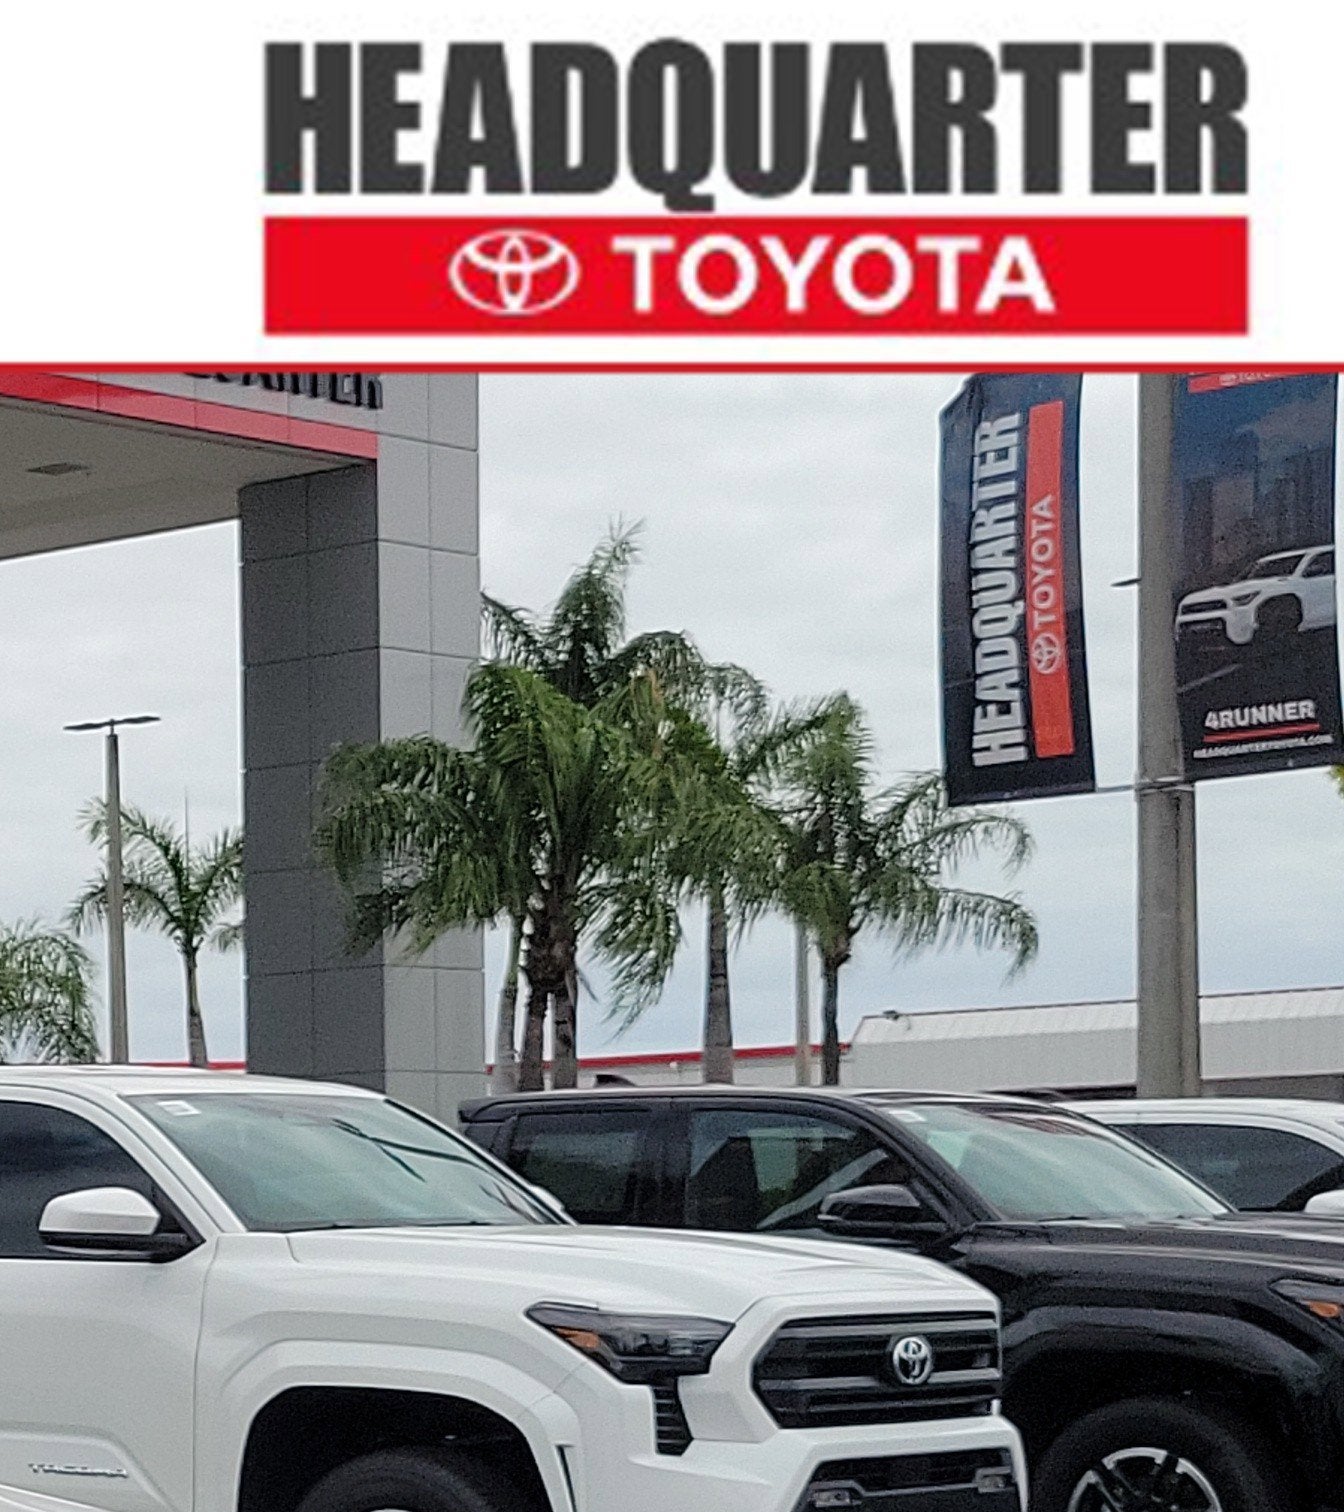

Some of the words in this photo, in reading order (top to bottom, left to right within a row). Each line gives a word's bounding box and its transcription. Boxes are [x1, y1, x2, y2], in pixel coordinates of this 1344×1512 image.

[970, 411, 1026, 766] HEADQUARTER
[1030, 494, 1056, 630] TOYOTA
[1205, 700, 1316, 731] 4RUNNER
